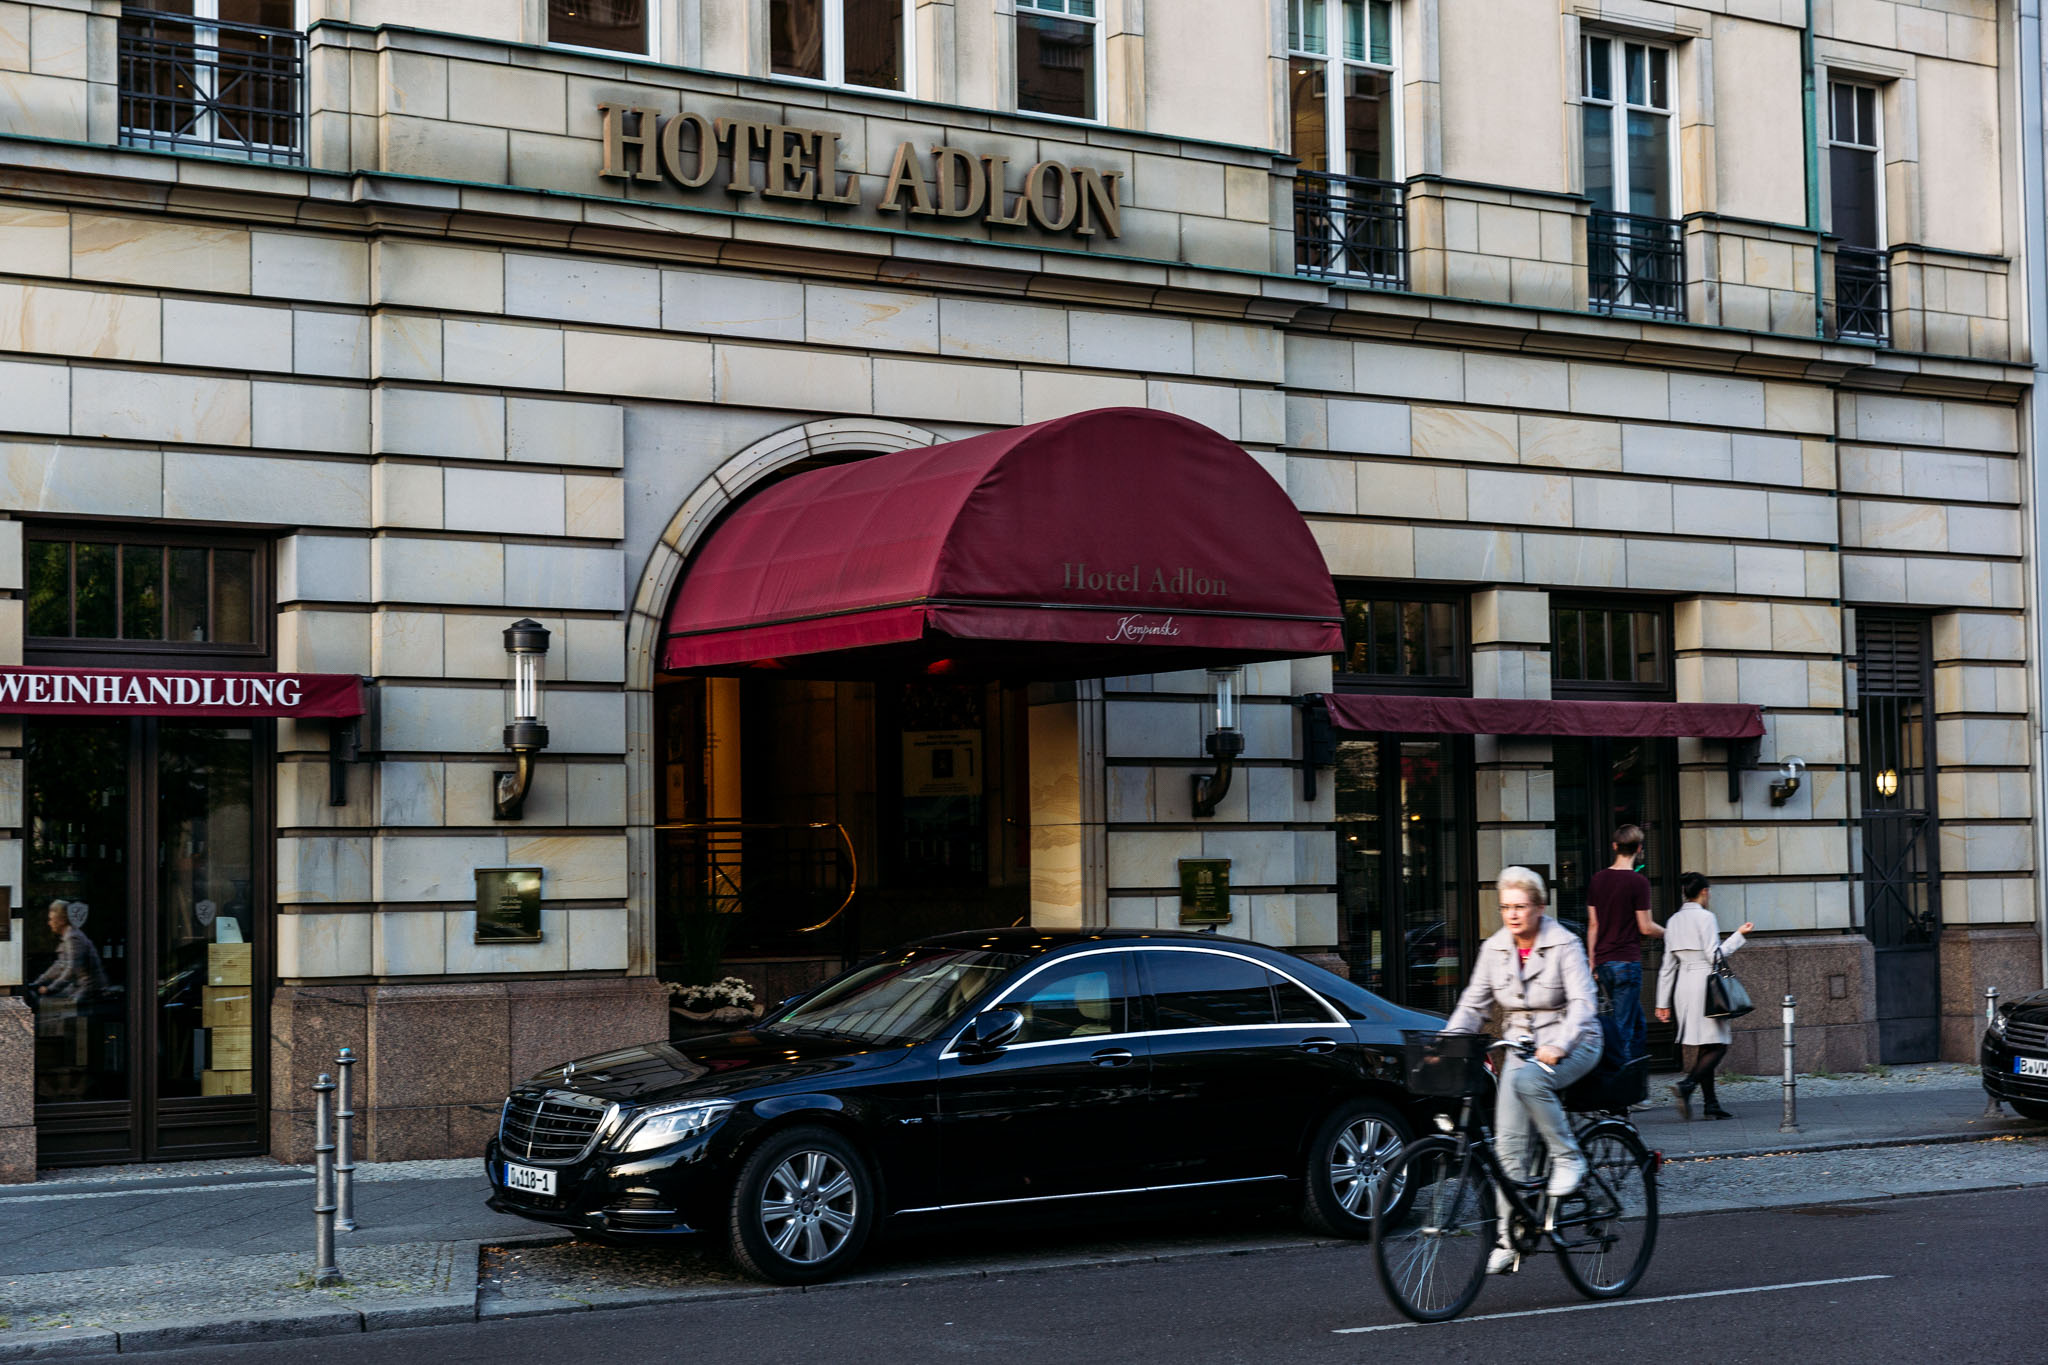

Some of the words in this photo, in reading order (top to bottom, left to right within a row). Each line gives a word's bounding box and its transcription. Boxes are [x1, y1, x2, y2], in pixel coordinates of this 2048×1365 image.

[597, 102, 861, 206] HOTEL
[877, 141, 1124, 239] ADLON
[1062, 562, 1140, 592] Hotel
[1149, 567, 1228, 596] Adlon
[1106, 613, 1181, 643] Kempinski
[0, 673, 303, 706] WEINHANDLUNG
